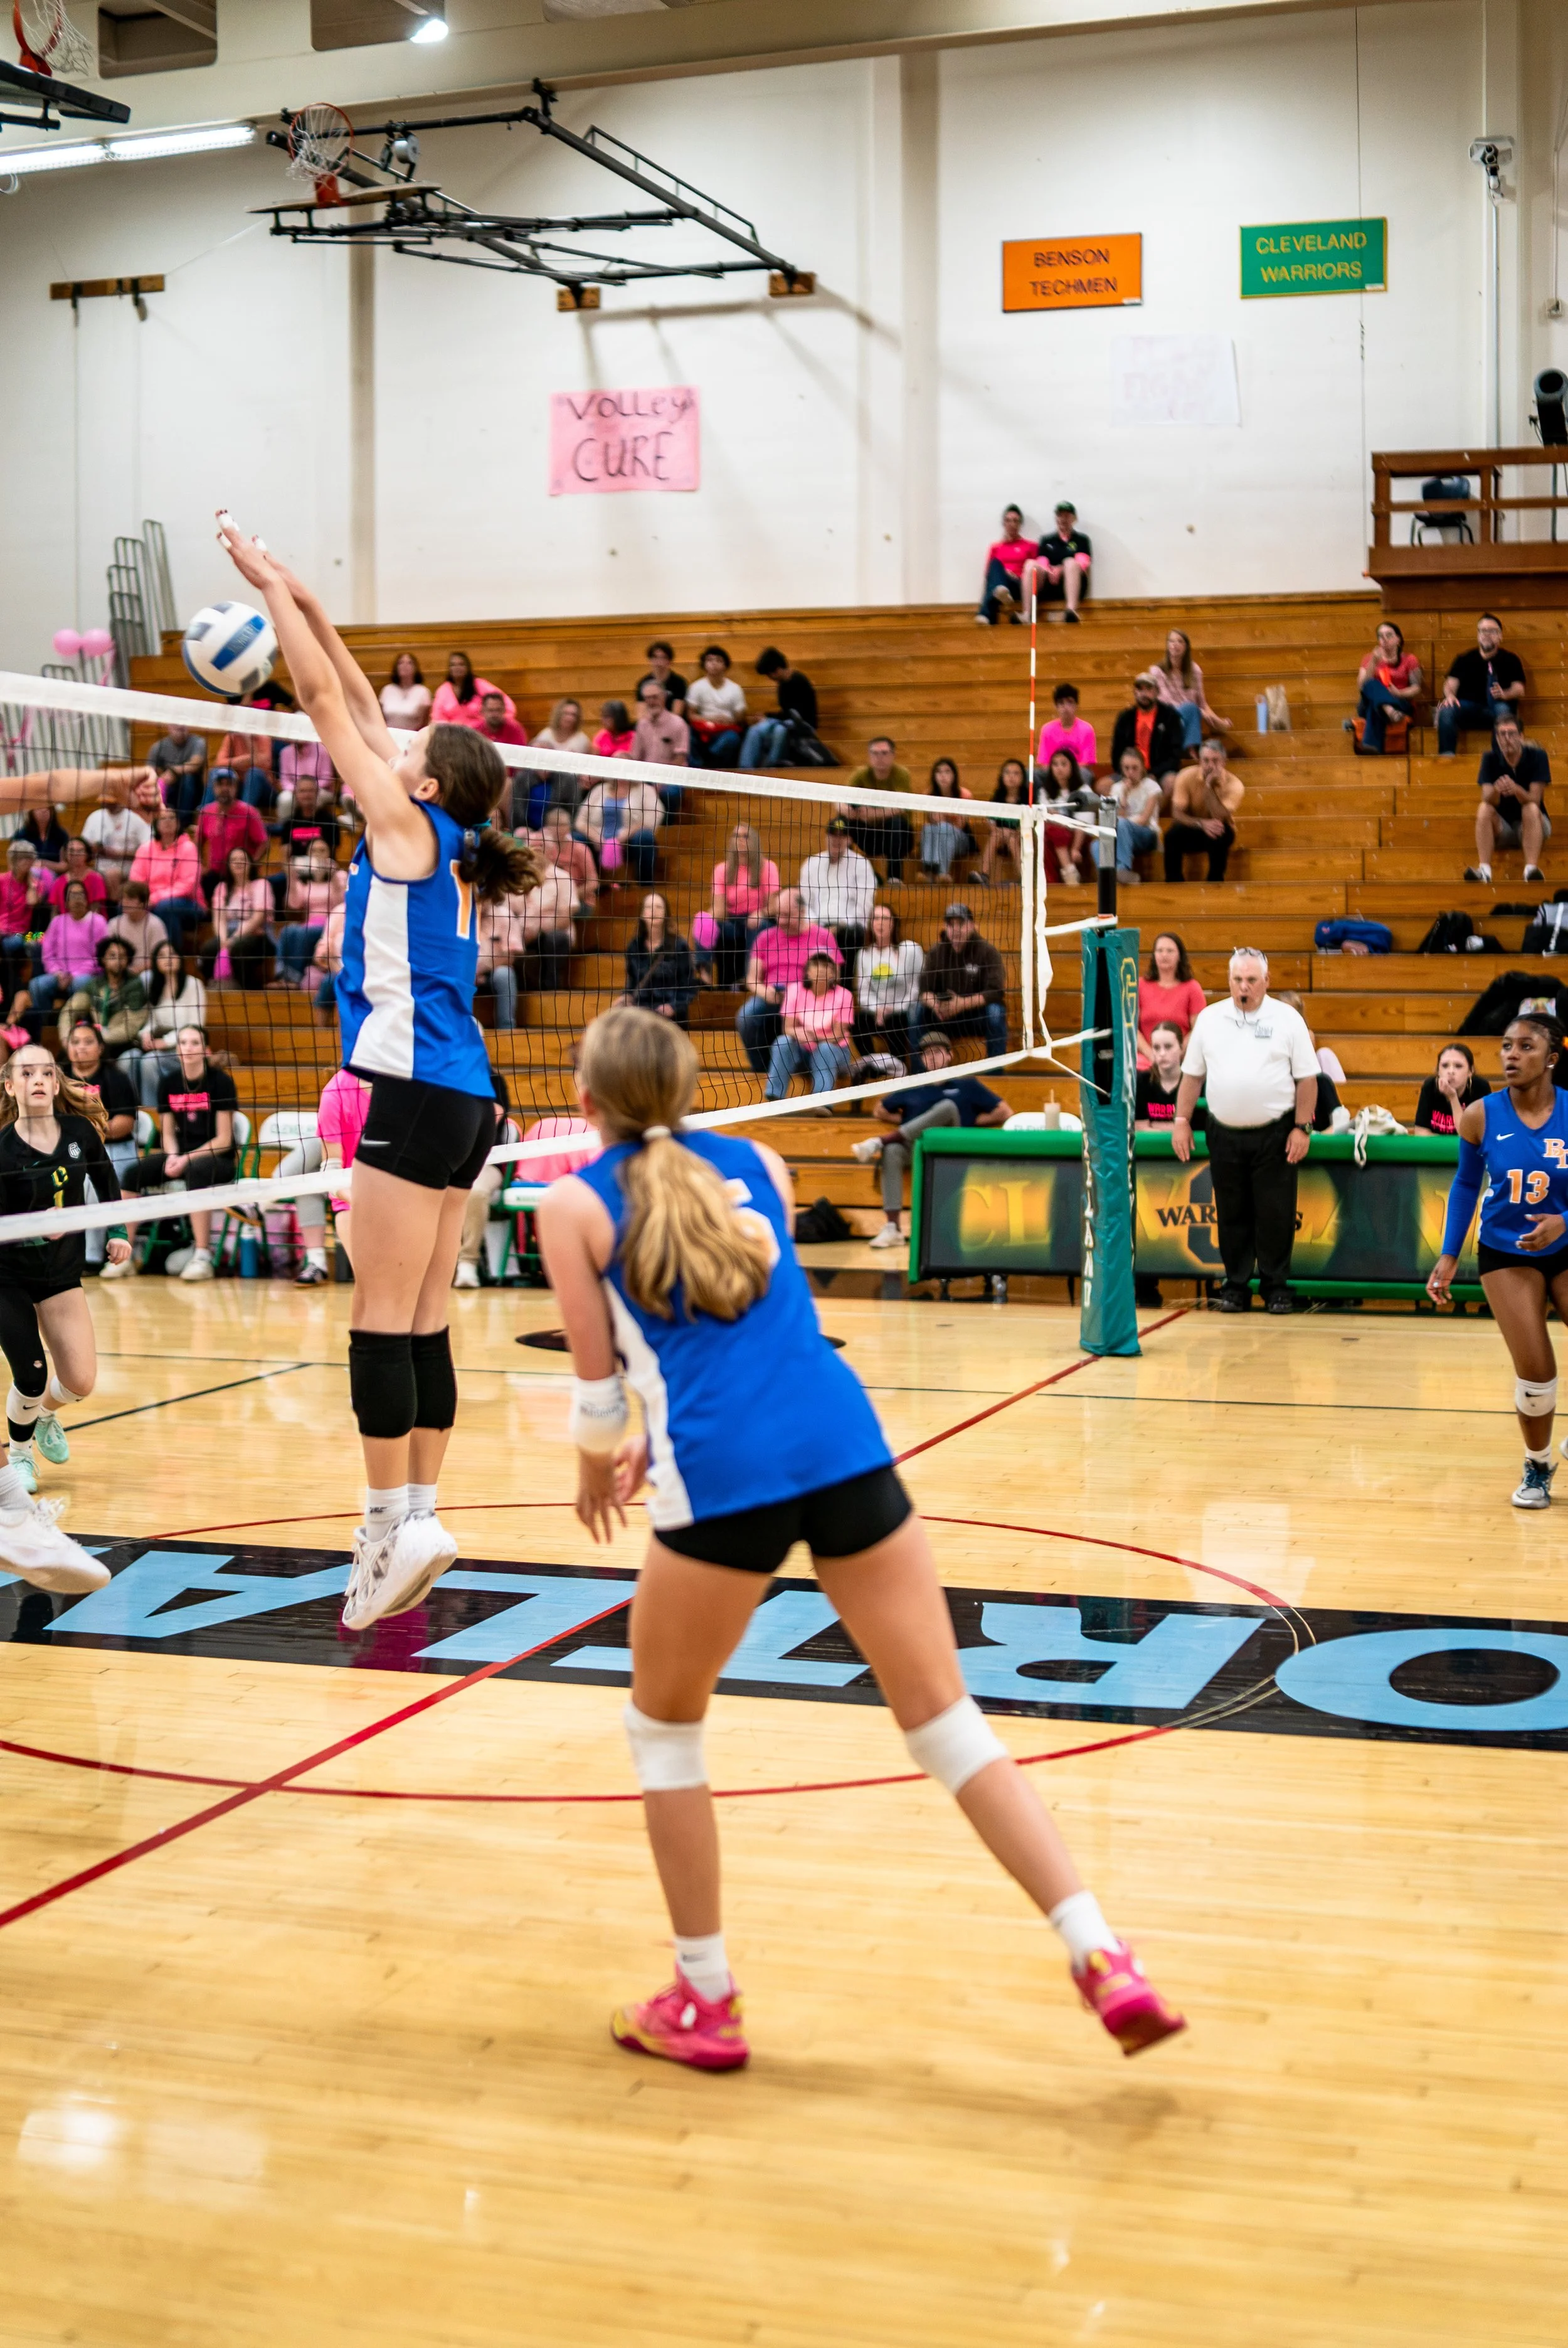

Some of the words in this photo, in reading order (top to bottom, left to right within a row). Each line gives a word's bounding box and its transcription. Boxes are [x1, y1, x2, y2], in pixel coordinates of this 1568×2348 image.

[1256, 231, 1368, 255] CLEVELAND
[1034, 248, 1110, 268] BENSON
[1260, 260, 1362, 282] WARRIORS
[1029, 277, 1117, 296] TECHMEN
[573, 431, 674, 482] CURE
[1507, 1169, 1550, 1204] 13
